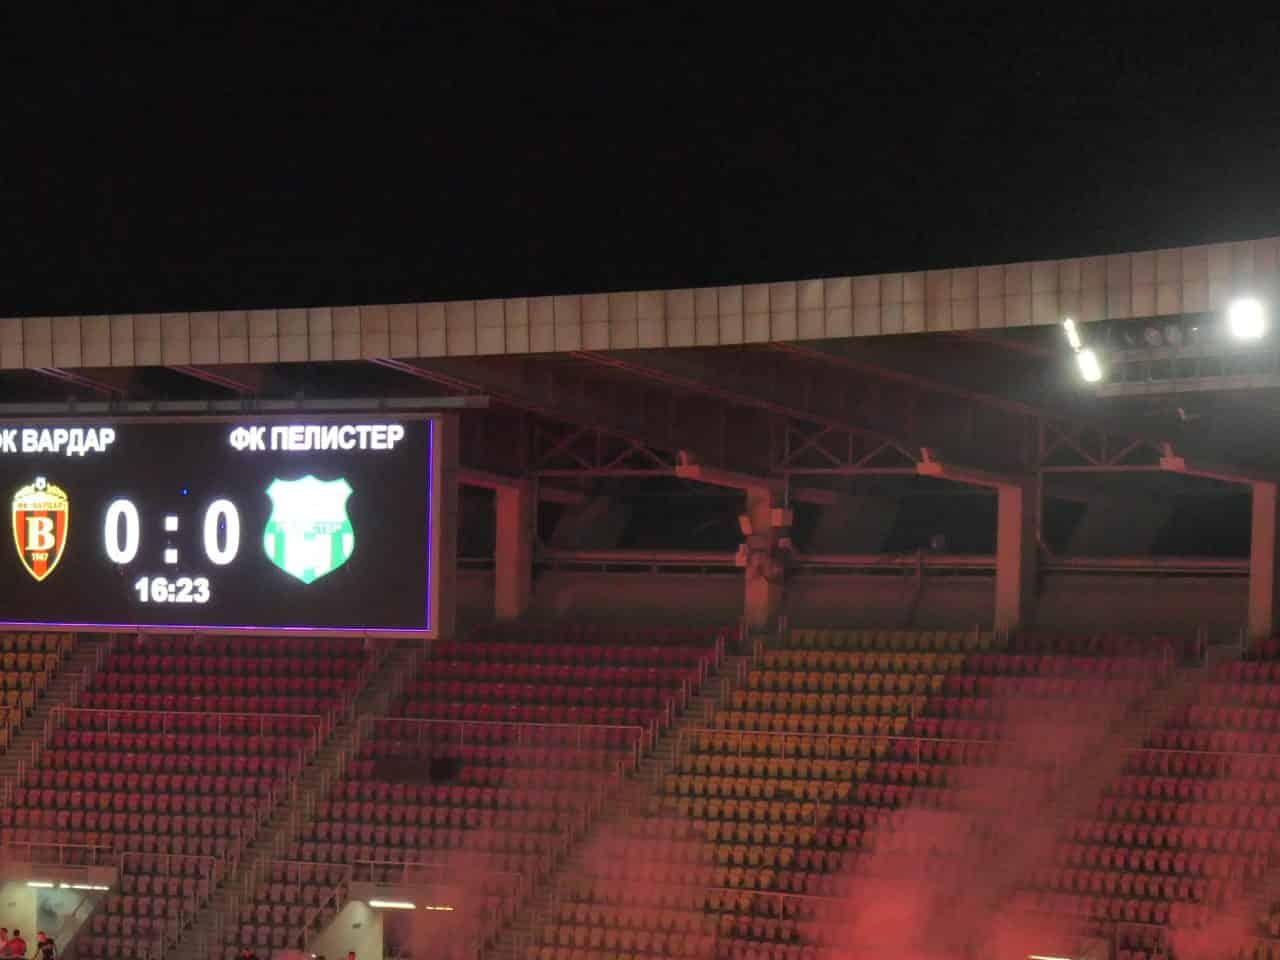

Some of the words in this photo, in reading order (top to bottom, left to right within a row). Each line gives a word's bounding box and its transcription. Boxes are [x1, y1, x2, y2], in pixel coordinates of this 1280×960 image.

[23, 428, 115, 456] ВАРДАР
[230, 426, 265, 450] ФК
[271, 424, 404, 451] ПЕЛИСТЕР
[104, 499, 140, 564] 0
[204, 499, 240, 565] 0
[135, 577, 210, 603] 16:23
